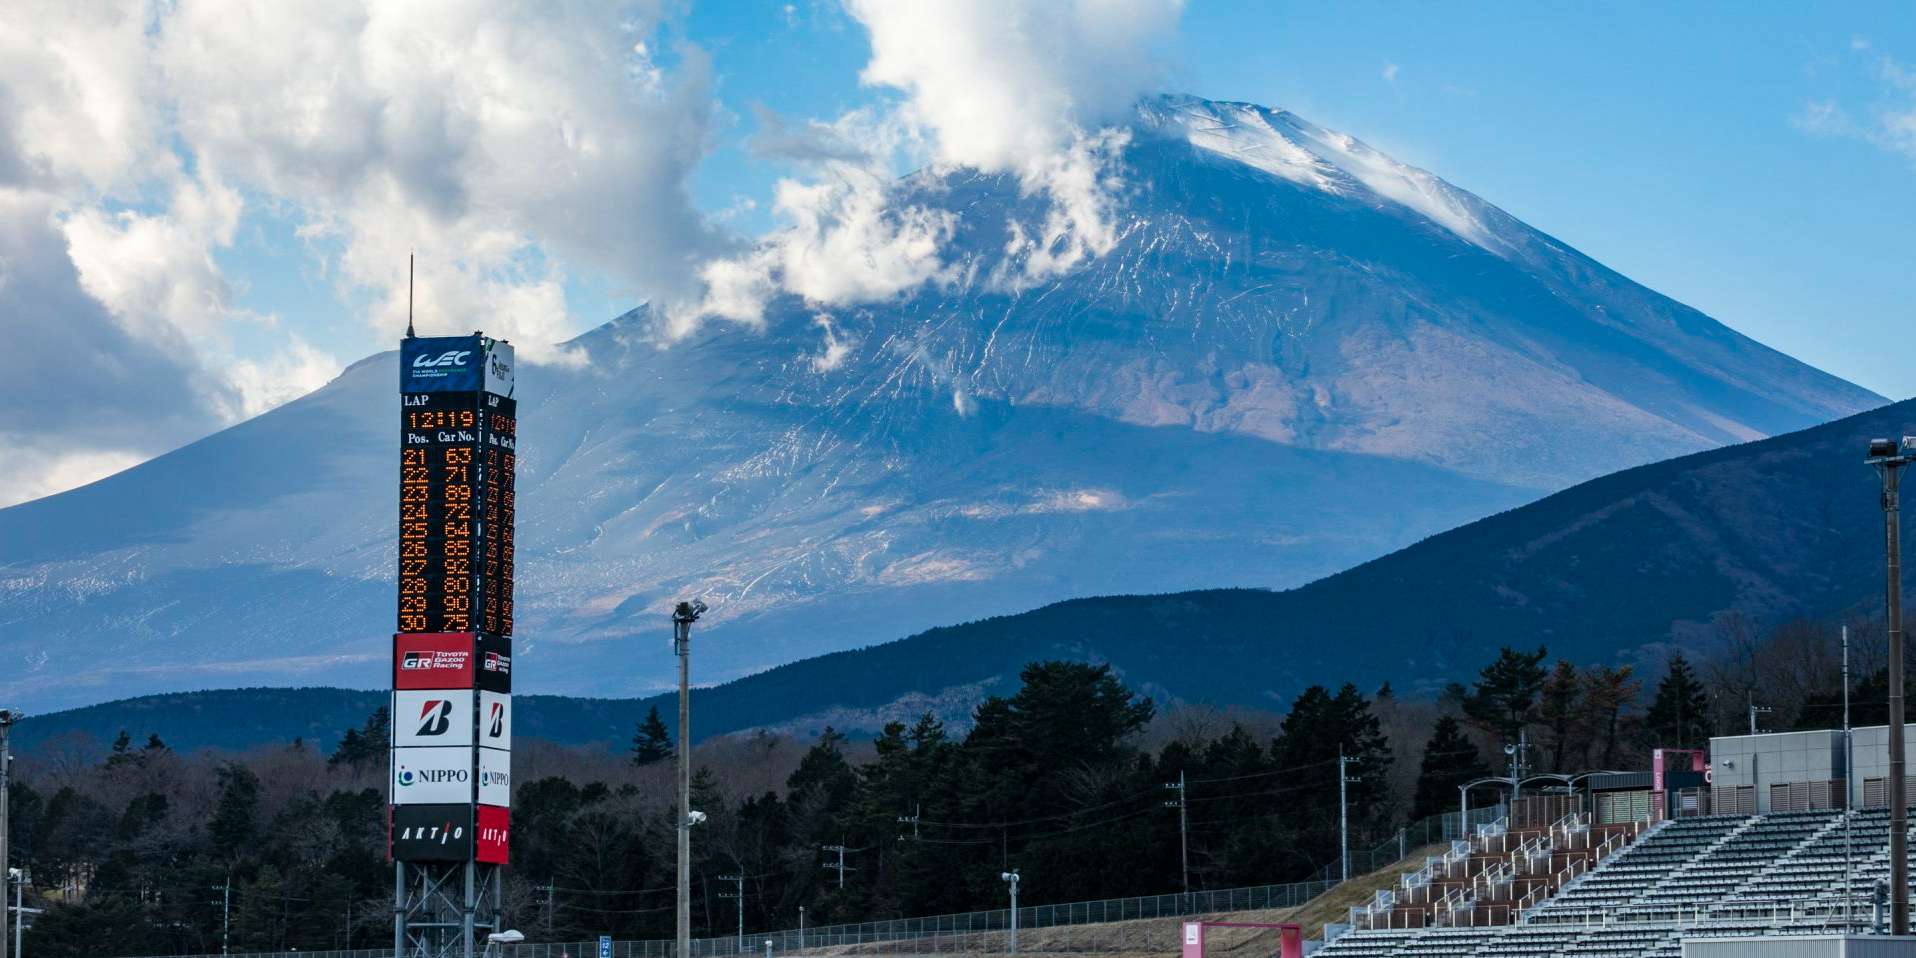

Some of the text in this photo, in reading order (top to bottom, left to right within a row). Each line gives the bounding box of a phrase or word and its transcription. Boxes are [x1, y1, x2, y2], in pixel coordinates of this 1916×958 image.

[412, 350, 472, 367] WEC
[405, 395, 429, 406] LAP
[410, 411, 473, 428] 12:19
[408, 433, 429, 444] Pos.
[438, 431, 475, 442] Car No.
[404, 448, 471, 464] 21 63
[404, 467, 466, 483] 22 71
[403, 485, 470, 501] 23 89
[403, 504, 470, 520] 24 72
[403, 522, 470, 538] 25 64
[403, 540, 469, 556] 26 85
[402, 559, 469, 575] 27 92
[402, 577, 469, 594] 28 80
[402, 596, 469, 612] 29 90
[401, 614, 468, 630] 30 75
[403, 658, 432, 668] GR
[485, 661, 496, 670] GR
[419, 770, 468, 782] NIPPO
[490, 771, 508, 786] NIPPO
